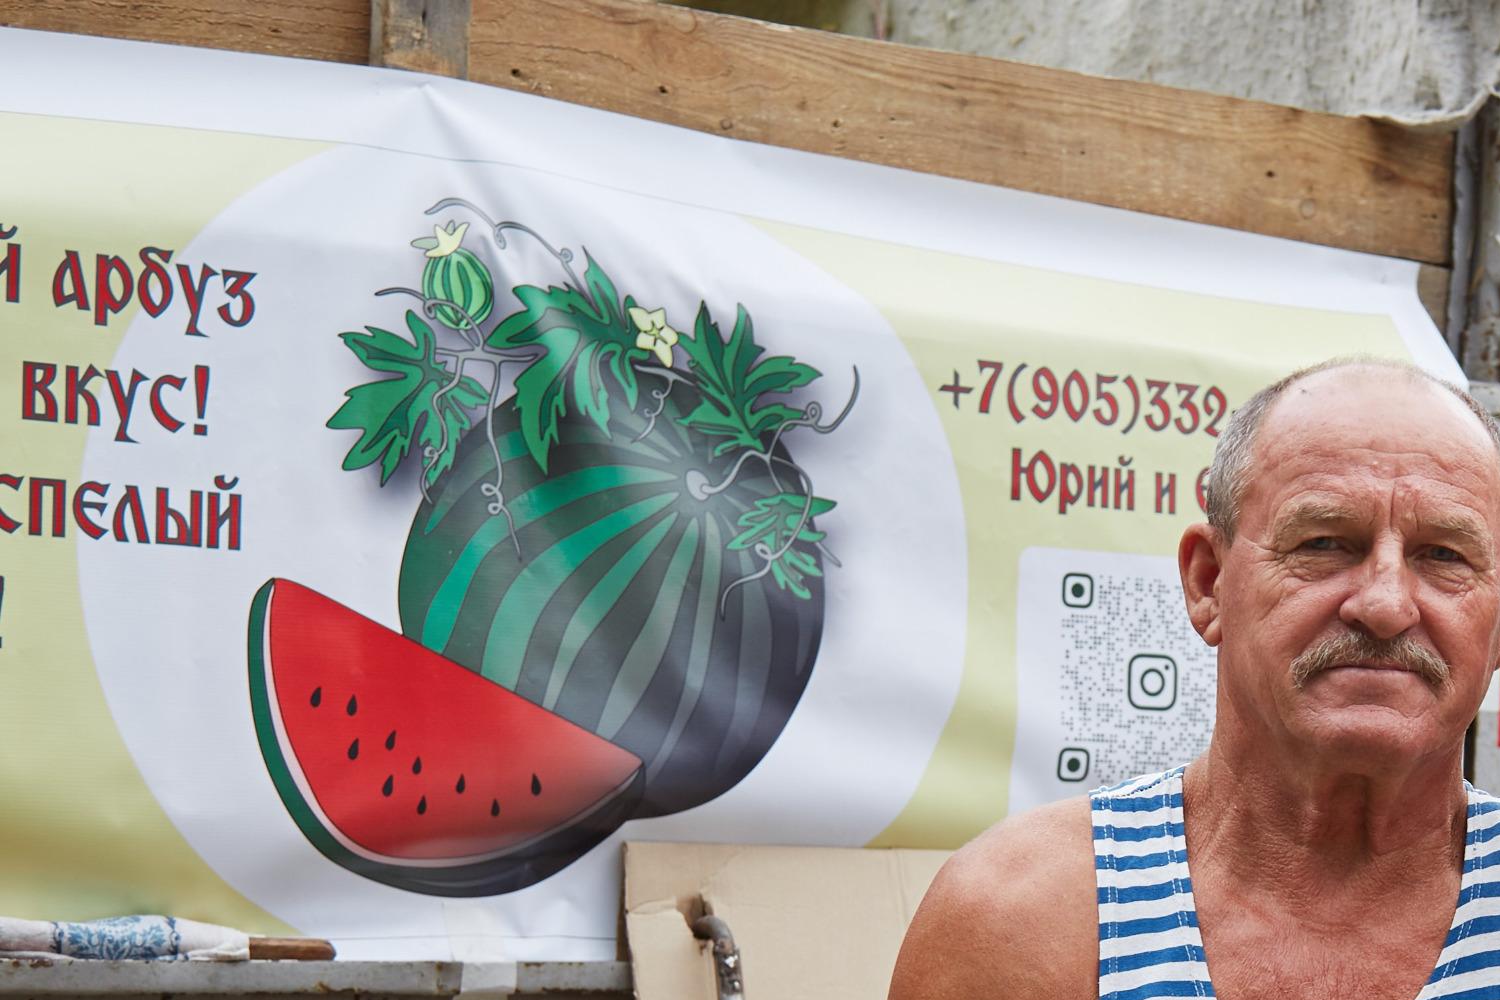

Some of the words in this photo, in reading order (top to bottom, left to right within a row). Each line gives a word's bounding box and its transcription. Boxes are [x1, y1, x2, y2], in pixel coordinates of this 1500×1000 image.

[52, 246, 258, 337] арбуз
[22, 360, 210, 444] вкус!
[1011, 447, 1135, 515] Юрий
[1154, 471, 1177, 515] и
